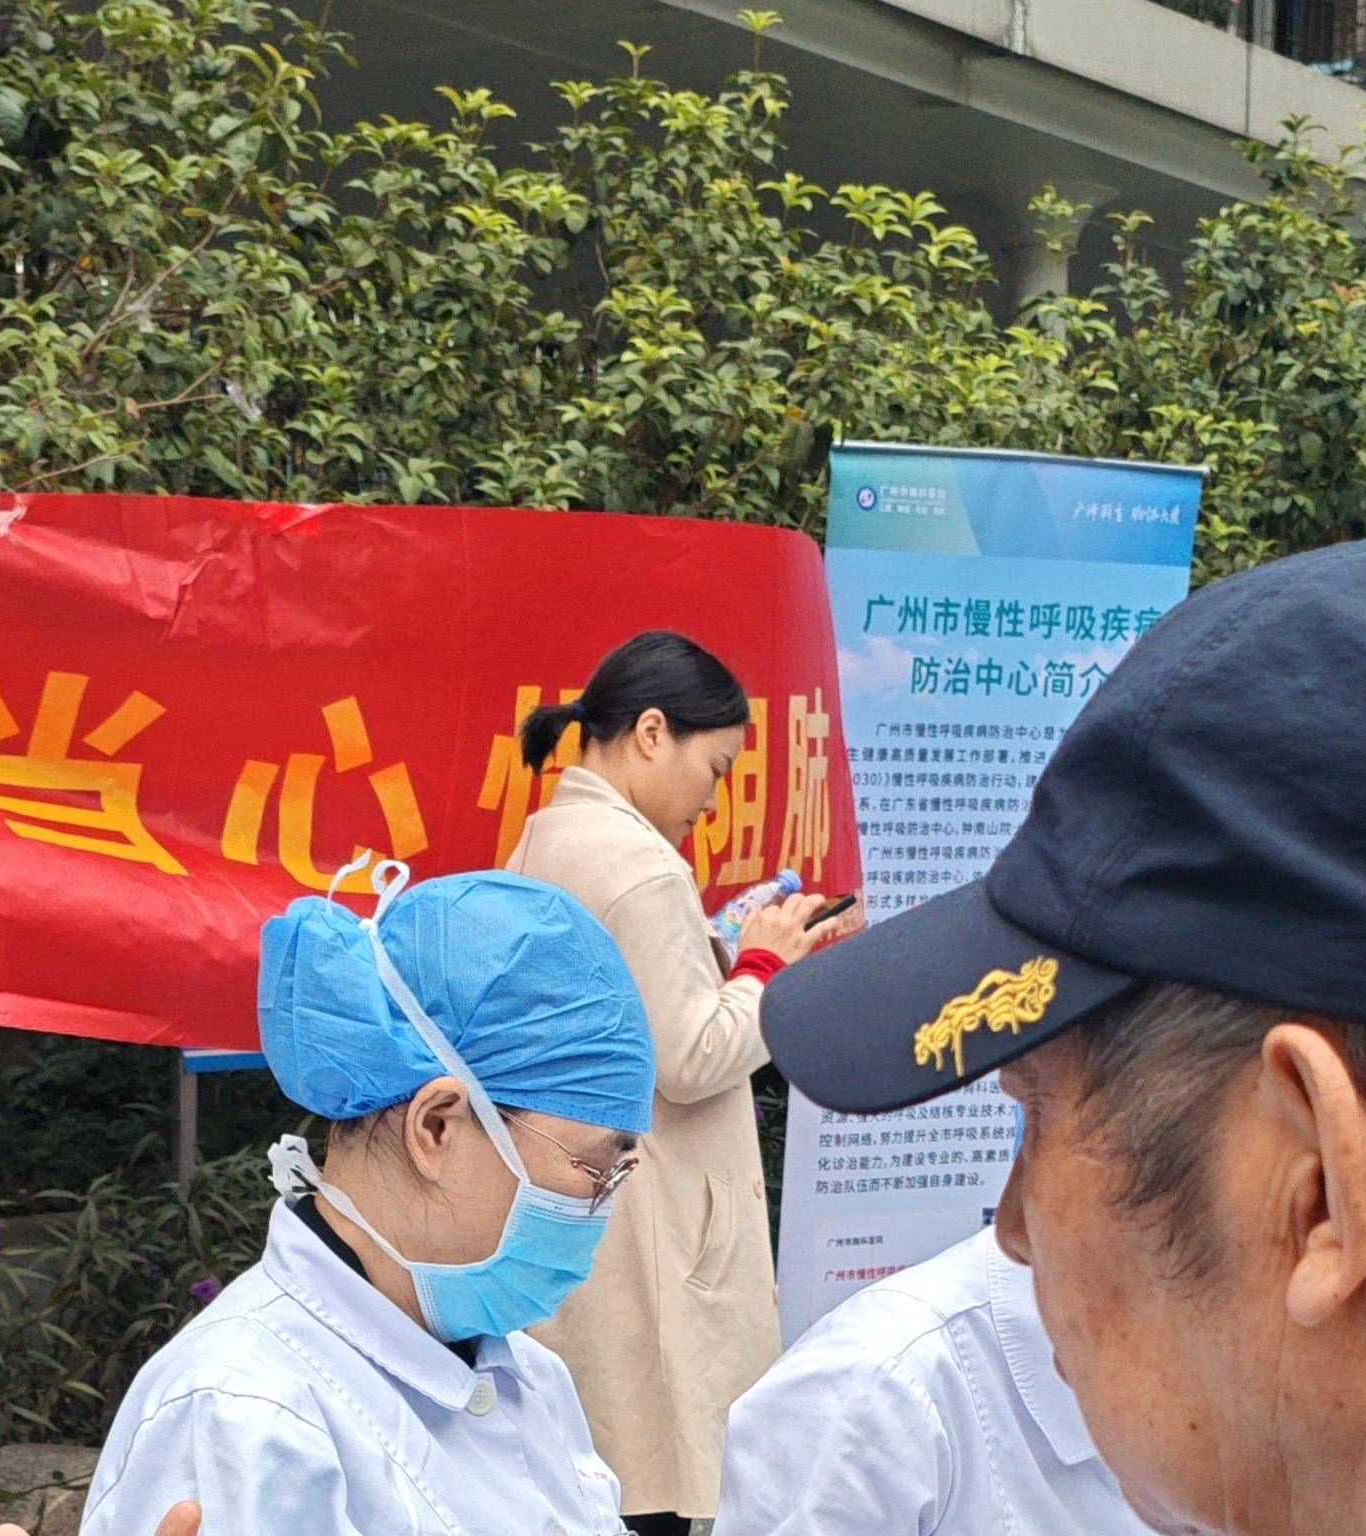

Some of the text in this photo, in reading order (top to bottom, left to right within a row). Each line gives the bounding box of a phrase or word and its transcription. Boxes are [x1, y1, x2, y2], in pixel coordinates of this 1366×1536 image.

[911, 656, 1109, 698] 防治中心简介
